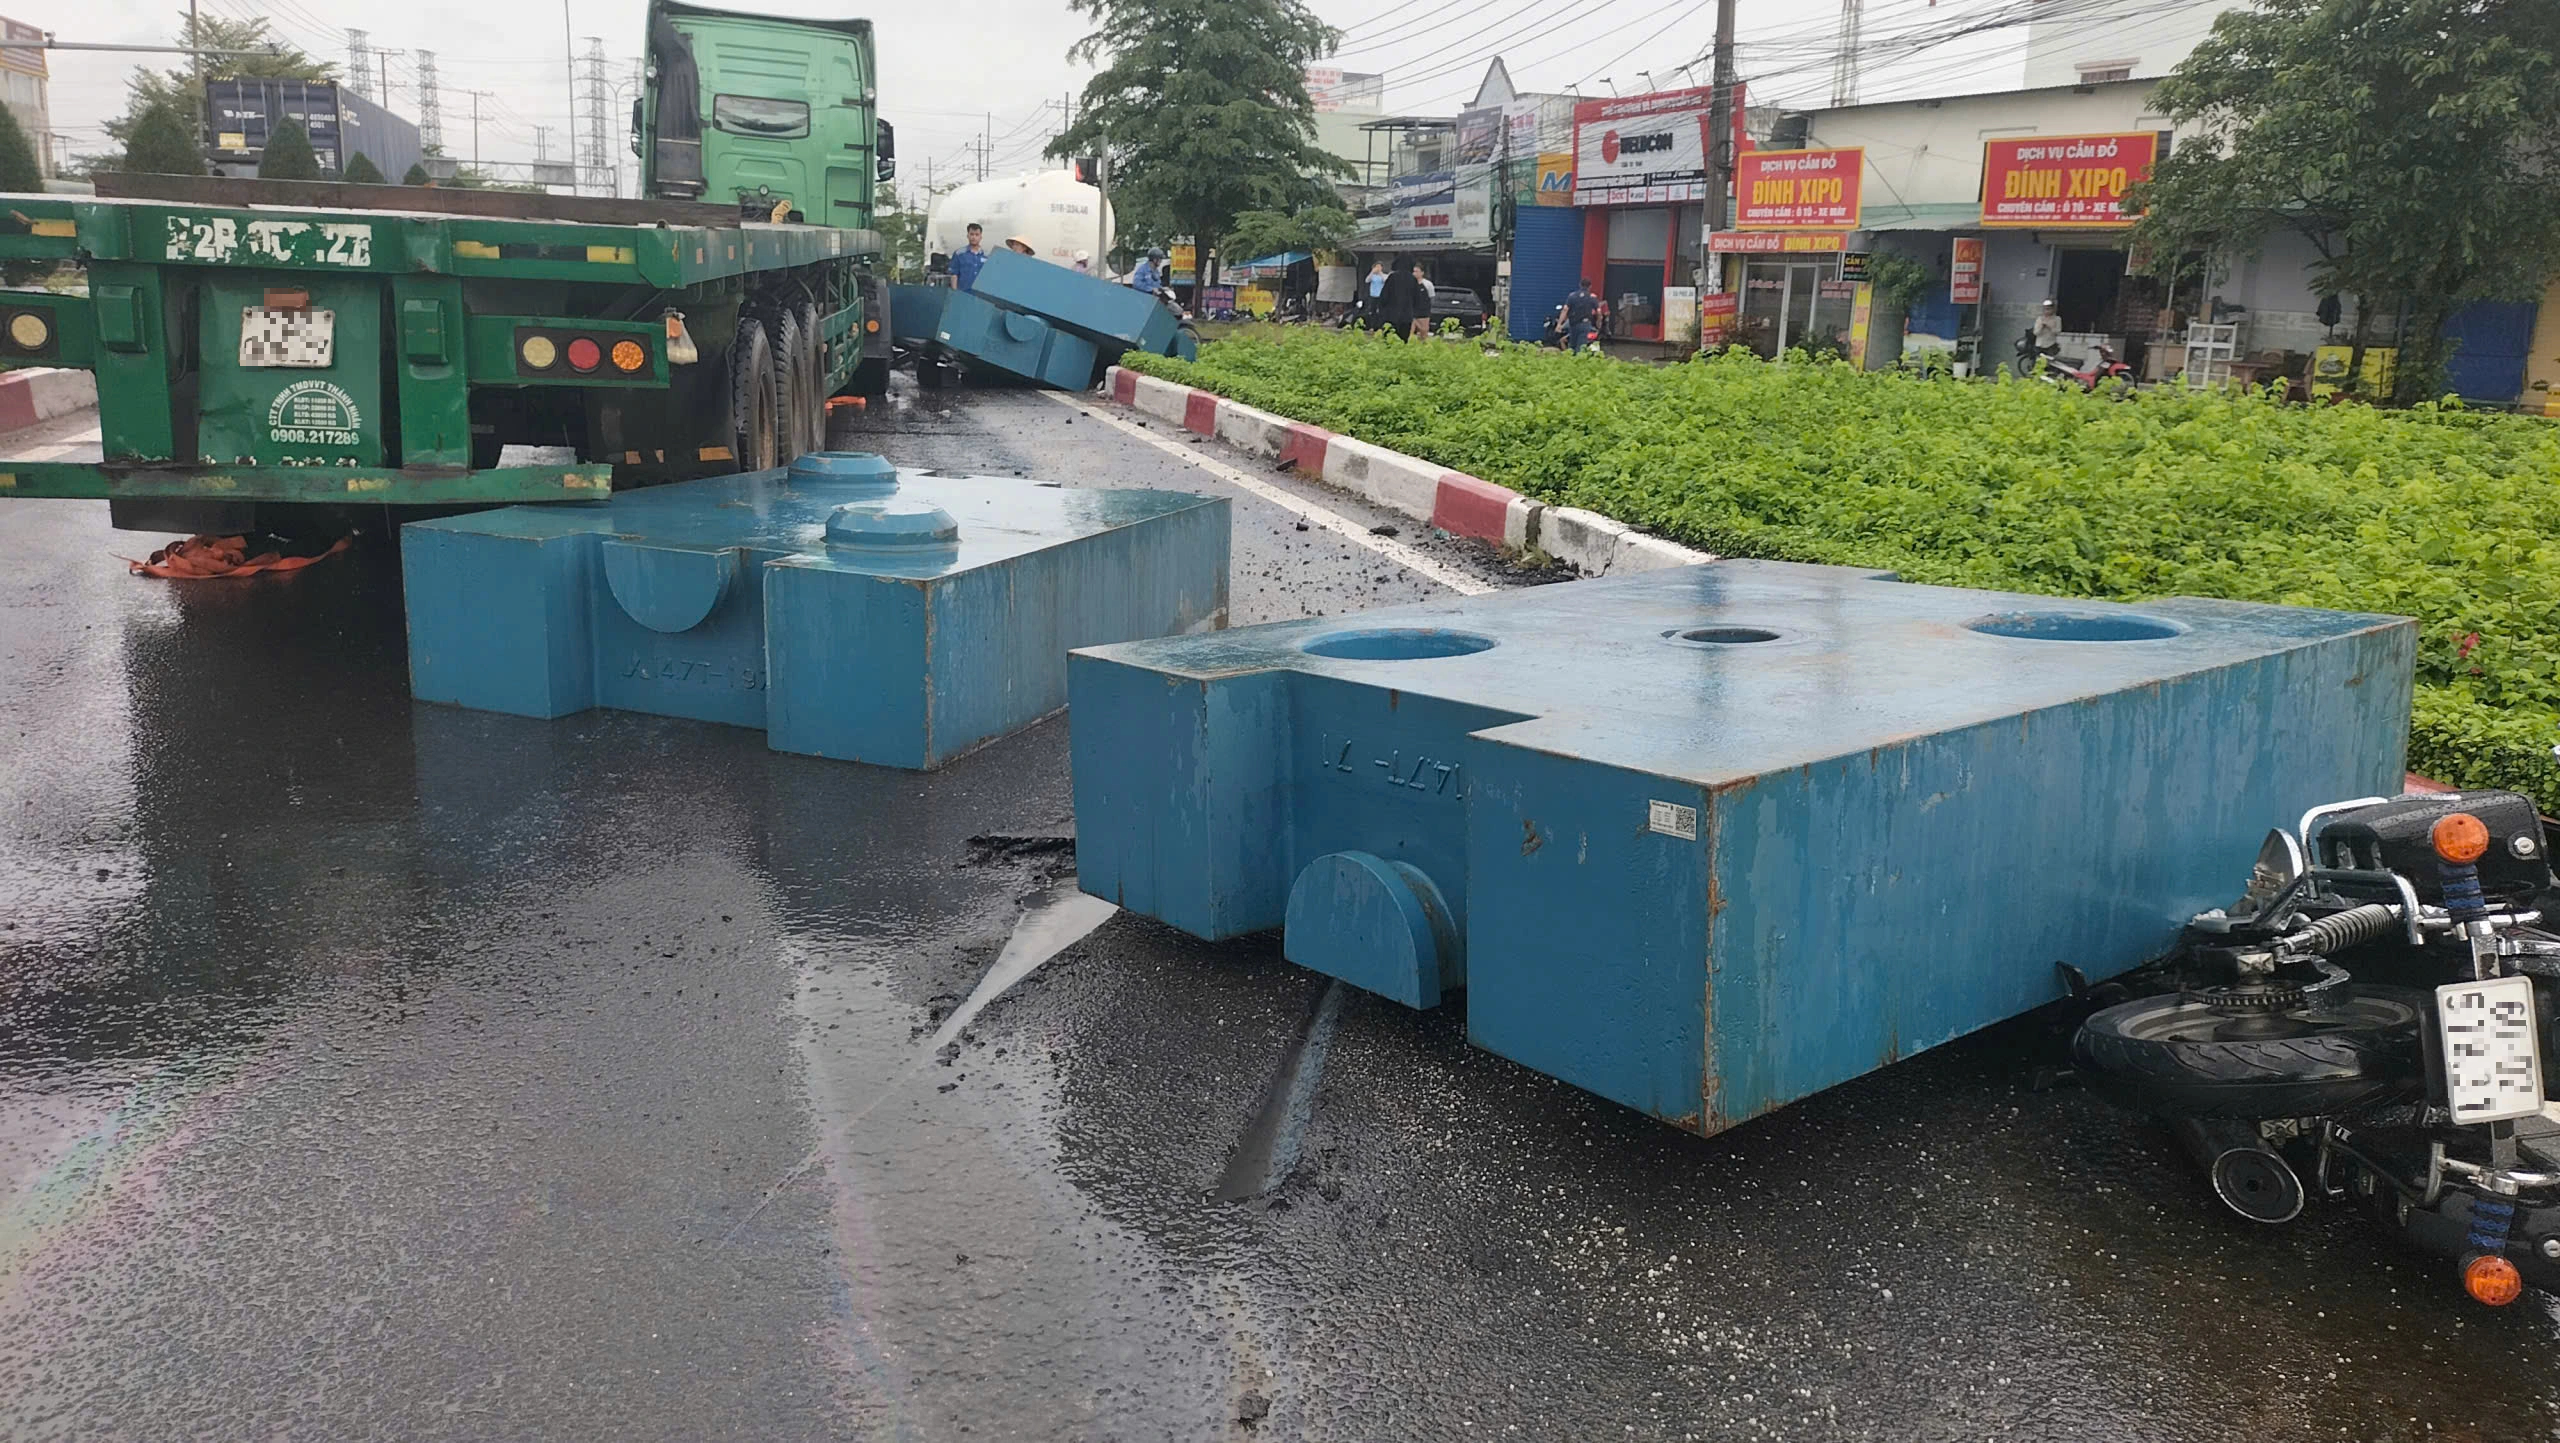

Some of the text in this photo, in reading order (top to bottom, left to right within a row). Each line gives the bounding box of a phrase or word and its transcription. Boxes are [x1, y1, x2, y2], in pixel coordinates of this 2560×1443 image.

[1620, 132, 1674, 154] WELDCOM
[2016, 138, 2118, 162] DỊCH VỤ CẦM ĐỒ
[1761, 160, 1782, 173] DỊCH
[1784, 159, 1796, 173] VỤ
[1798, 177, 1843, 204] XIPO
[2066, 167, 2127, 198] XIPO
[1818, 207, 1828, 217] XE
[1997, 200, 2033, 213] CHUYÊN
[2092, 203, 2106, 212] XE
[1714, 238, 1734, 250] DỊCH
[1735, 238, 1746, 250] VỤ
[1814, 236, 1840, 250] XIPO
[272, 388, 292, 408] TNHH
[268, 408, 278, 426] CTY
[270, 428, 360, 445] 0908.217289
